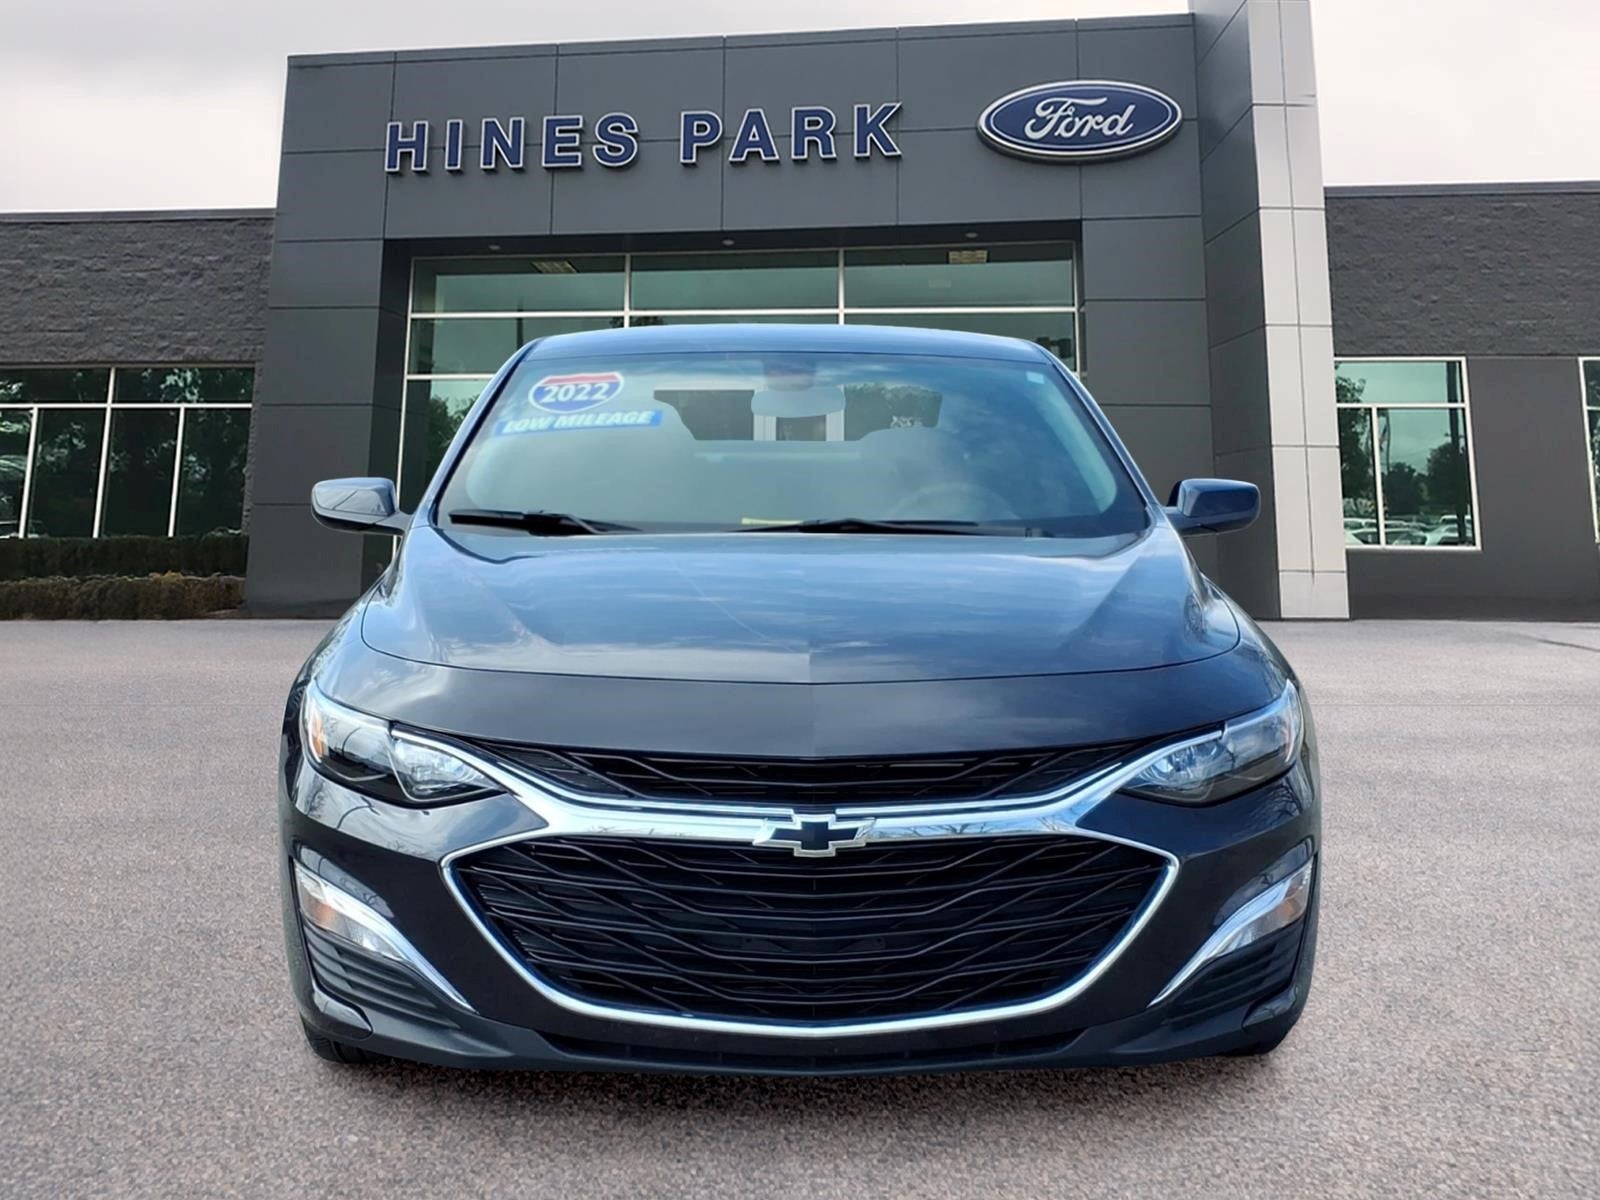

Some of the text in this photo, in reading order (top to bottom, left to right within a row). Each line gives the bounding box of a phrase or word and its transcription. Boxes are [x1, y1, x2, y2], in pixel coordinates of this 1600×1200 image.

[1024, 97, 1136, 140] Ford
[384, 101, 903, 174] HINES PARK
[540, 383, 610, 403] 2022
[502, 410, 654, 434] LOW MILEAGE
